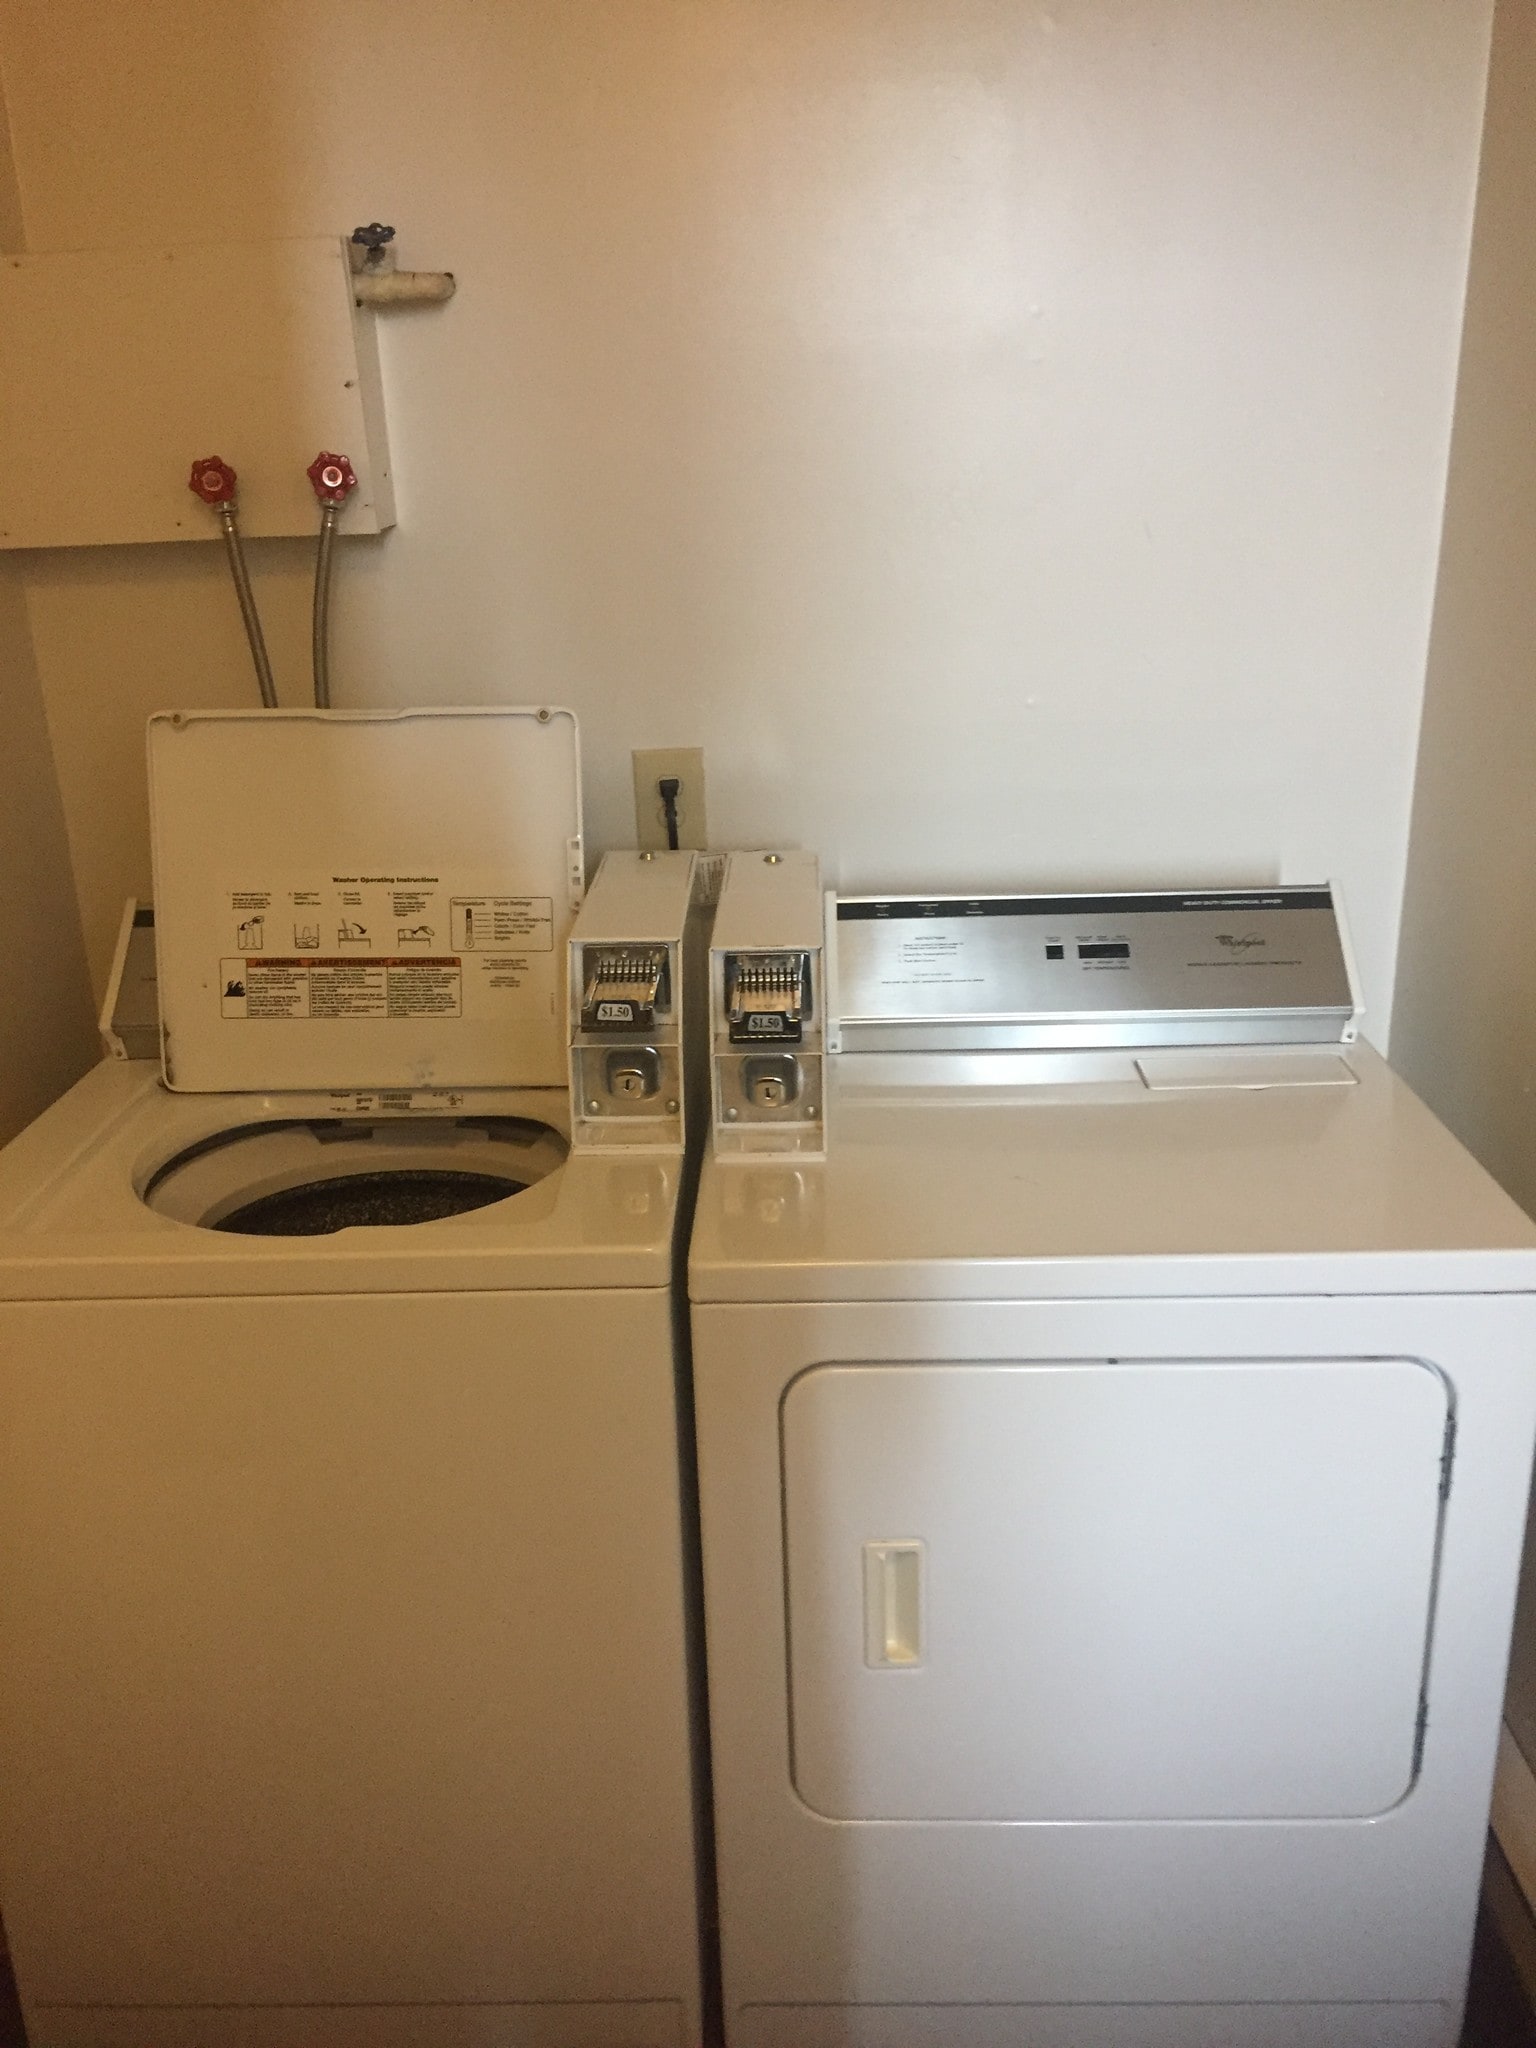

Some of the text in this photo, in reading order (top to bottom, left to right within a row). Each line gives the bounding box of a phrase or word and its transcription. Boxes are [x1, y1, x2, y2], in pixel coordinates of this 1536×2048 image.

[360, 876, 395, 884] Operating
[601, 1005, 630, 1018] $1.50
[751, 1016, 781, 1029] $1.50
